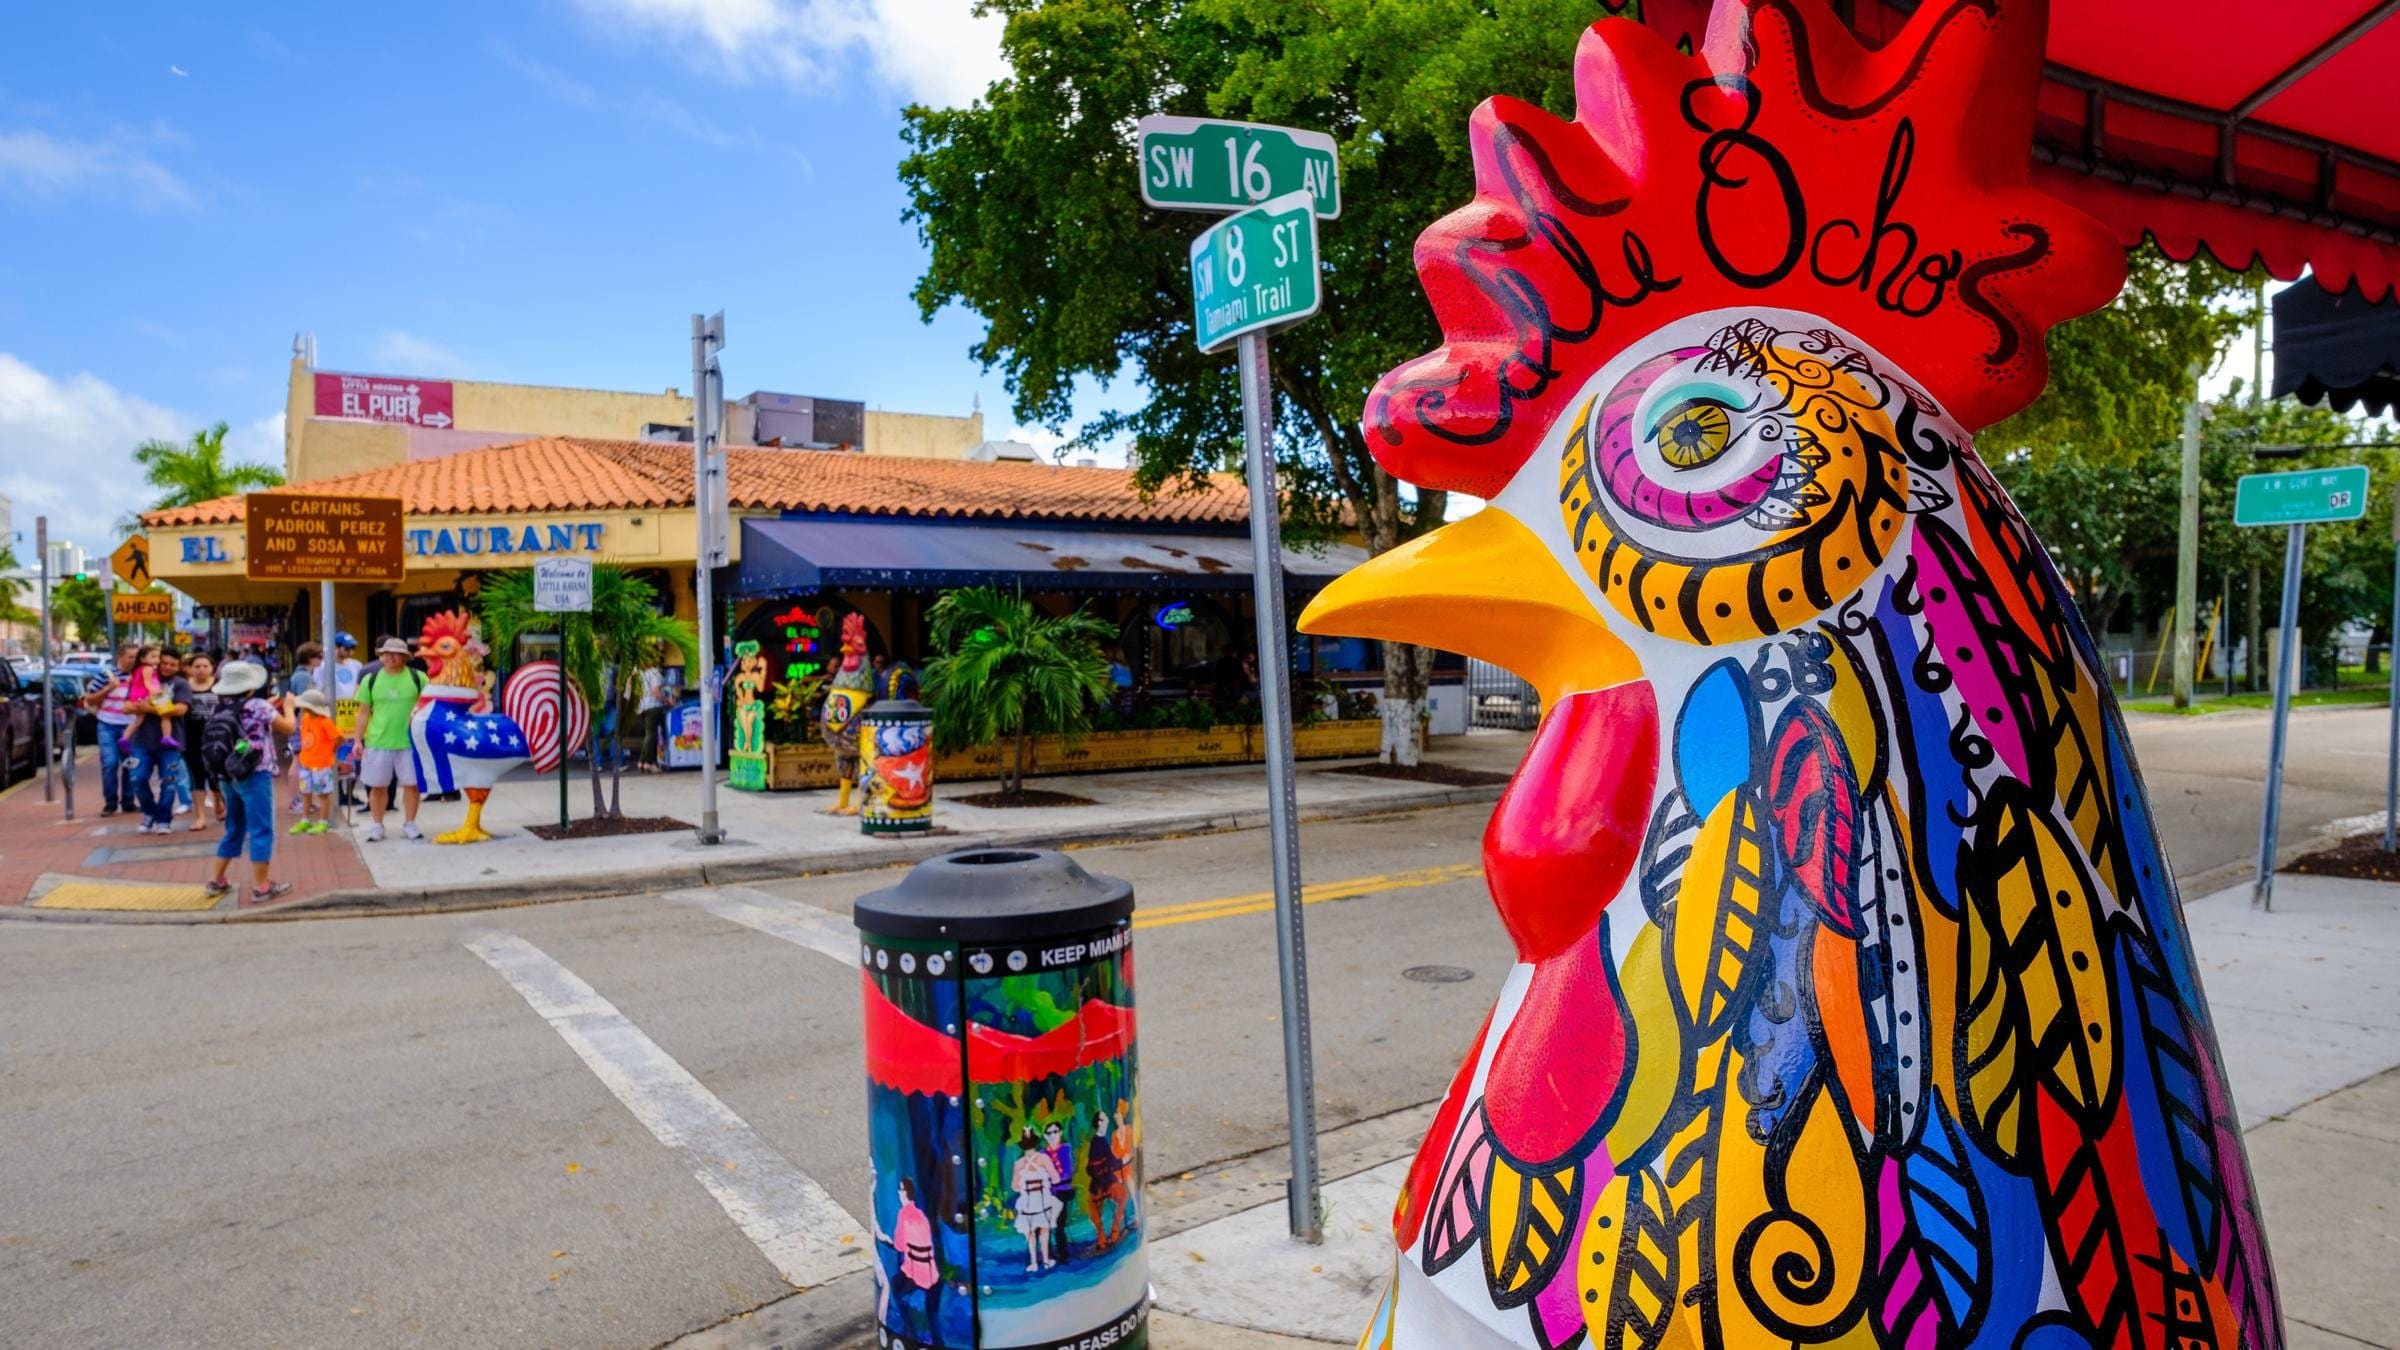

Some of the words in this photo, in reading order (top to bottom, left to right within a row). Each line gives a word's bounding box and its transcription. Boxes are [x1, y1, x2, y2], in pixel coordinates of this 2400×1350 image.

[1151, 145, 1194, 189] SW
[1225, 137, 1272, 200] 16
[1303, 158, 1329, 199] AV
[1680, 74, 1963, 317] Ocho
[1197, 254, 1213, 301] SW
[1226, 224, 1247, 288] 8
[1272, 219, 1300, 269] ST
[1204, 290, 1248, 336] Tamiami
[1253, 277, 1291, 316] Trail
[342, 393, 366, 415] EL
[369, 394, 407, 417] PUB
[2330, 491, 2350, 508] DR
[340, 521, 386, 536] PEREZ
[179, 536, 227, 563] EL
[405, 523, 604, 557] TAURANT
[265, 537, 296, 552] AND
[308, 539, 346, 553] SOSA
[356, 540, 386, 554] WAY
[540, 566, 575, 578] Welcome
[115, 601, 169, 616] AHEAD
[554, 593, 570, 604] USA
[1041, 944, 1086, 967] KEEP
[1089, 932, 1123, 959] MIAMI
[1120, 1313, 1137, 1337] DO
